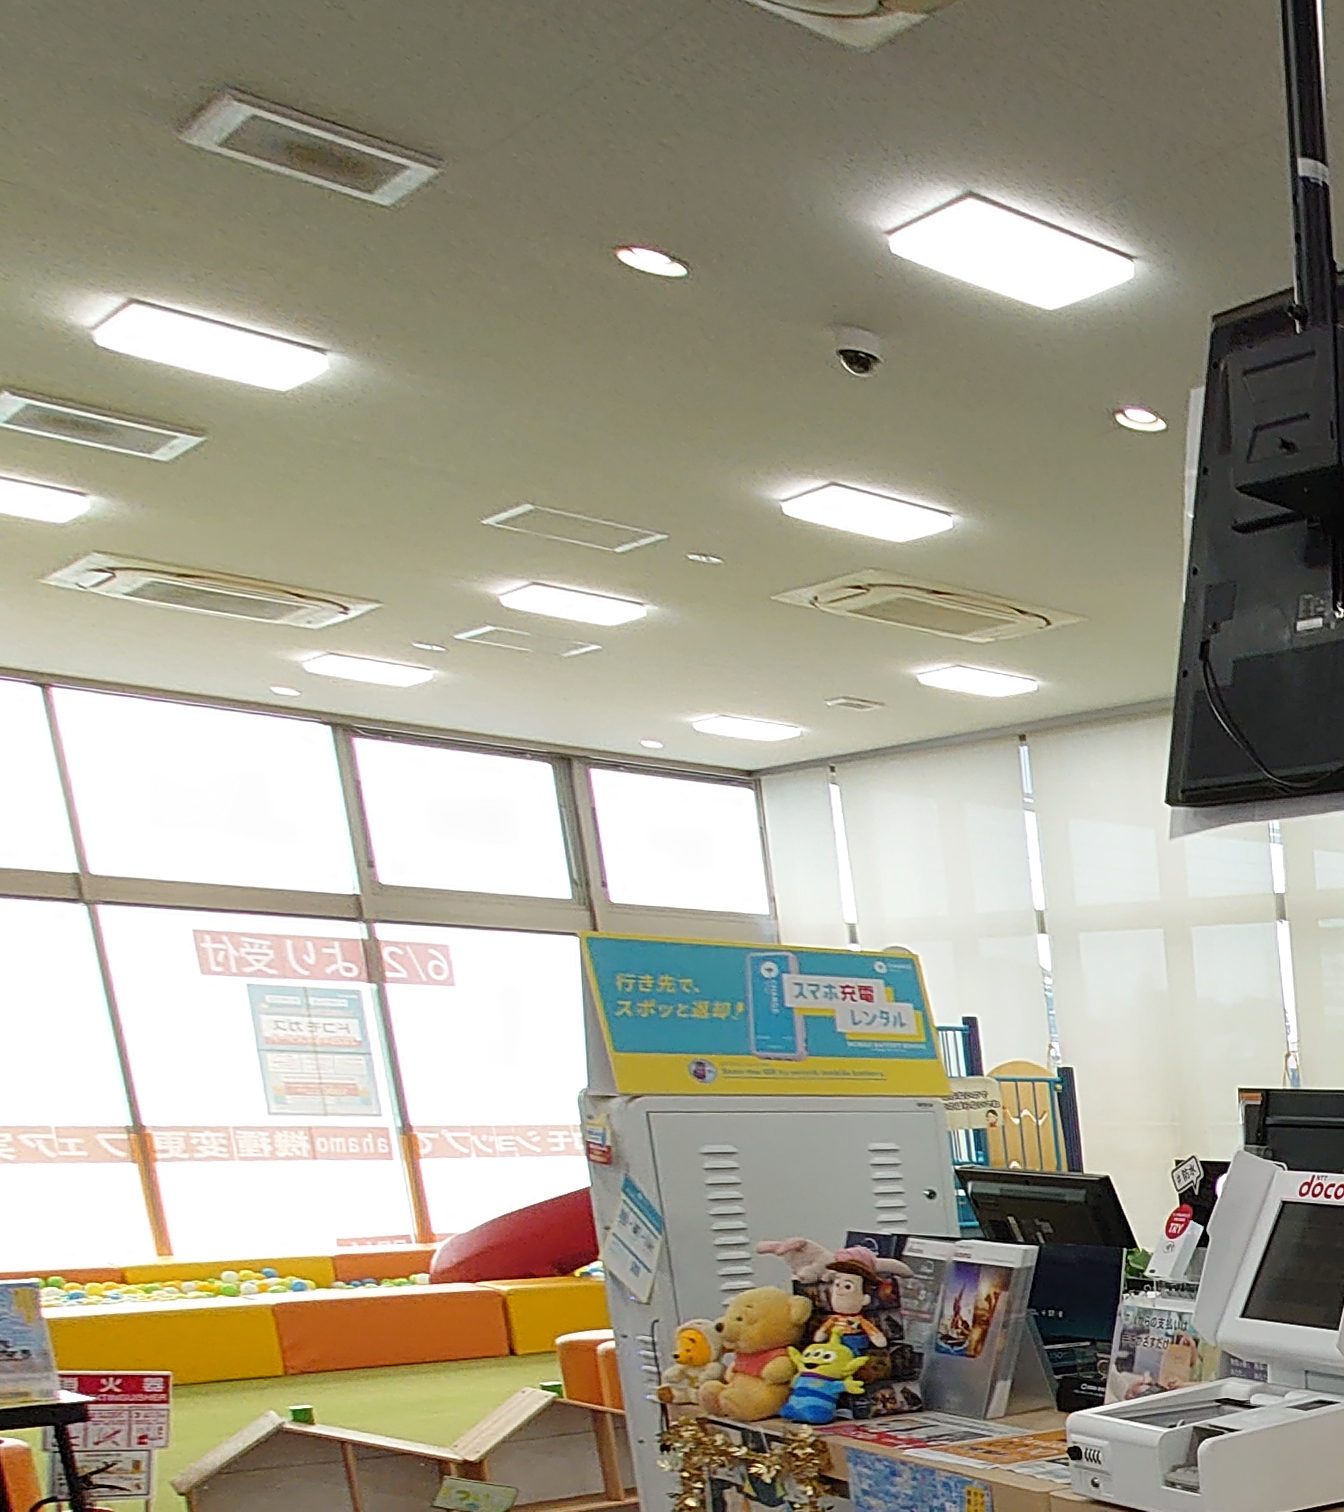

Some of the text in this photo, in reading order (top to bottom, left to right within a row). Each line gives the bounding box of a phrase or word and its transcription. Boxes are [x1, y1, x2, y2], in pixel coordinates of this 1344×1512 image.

[615, 974, 700, 994] 行き先で、
[793, 982, 874, 1003] スマホ充電
[851, 1010, 906, 1027] レンタル
